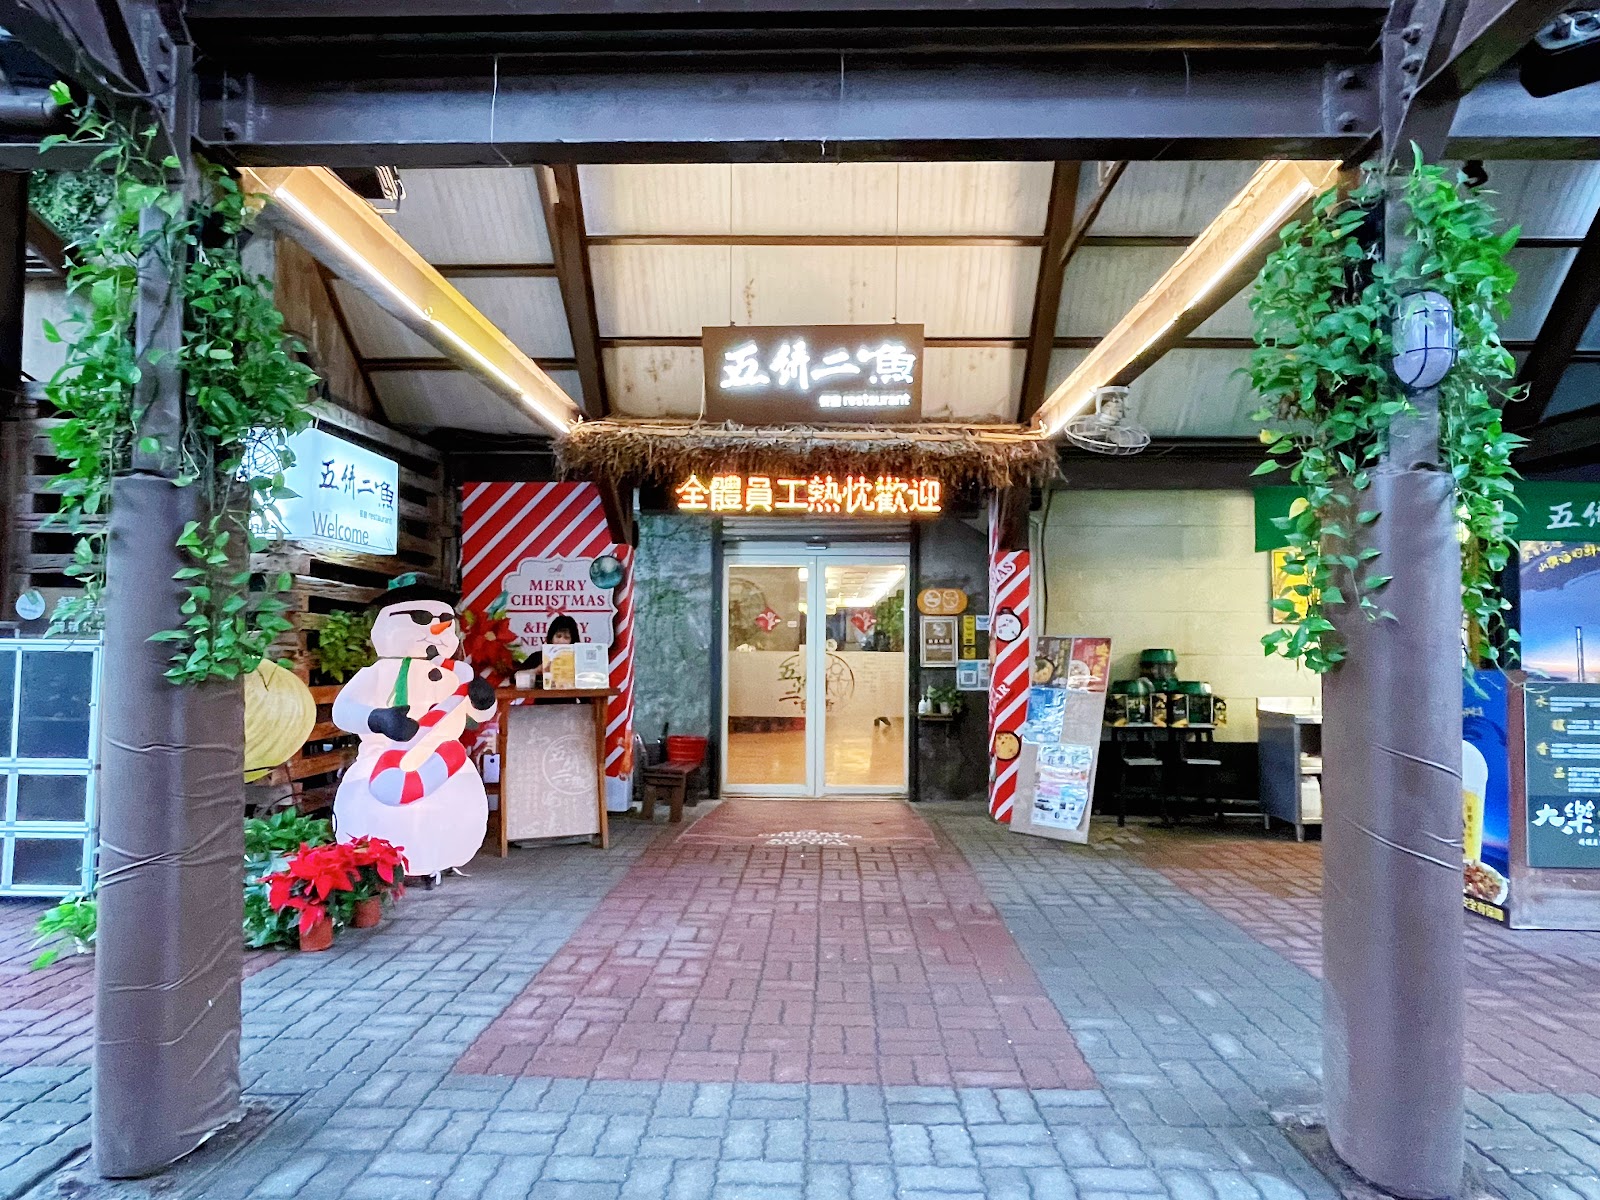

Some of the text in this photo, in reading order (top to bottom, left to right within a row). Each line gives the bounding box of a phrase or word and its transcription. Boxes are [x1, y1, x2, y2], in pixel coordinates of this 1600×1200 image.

[676, 472, 942, 513] 全體員工熱忱歡迎
[311, 510, 369, 545] Welcome
[529, 579, 587, 592] MERRY
[510, 594, 606, 607] CHRISTMAS
